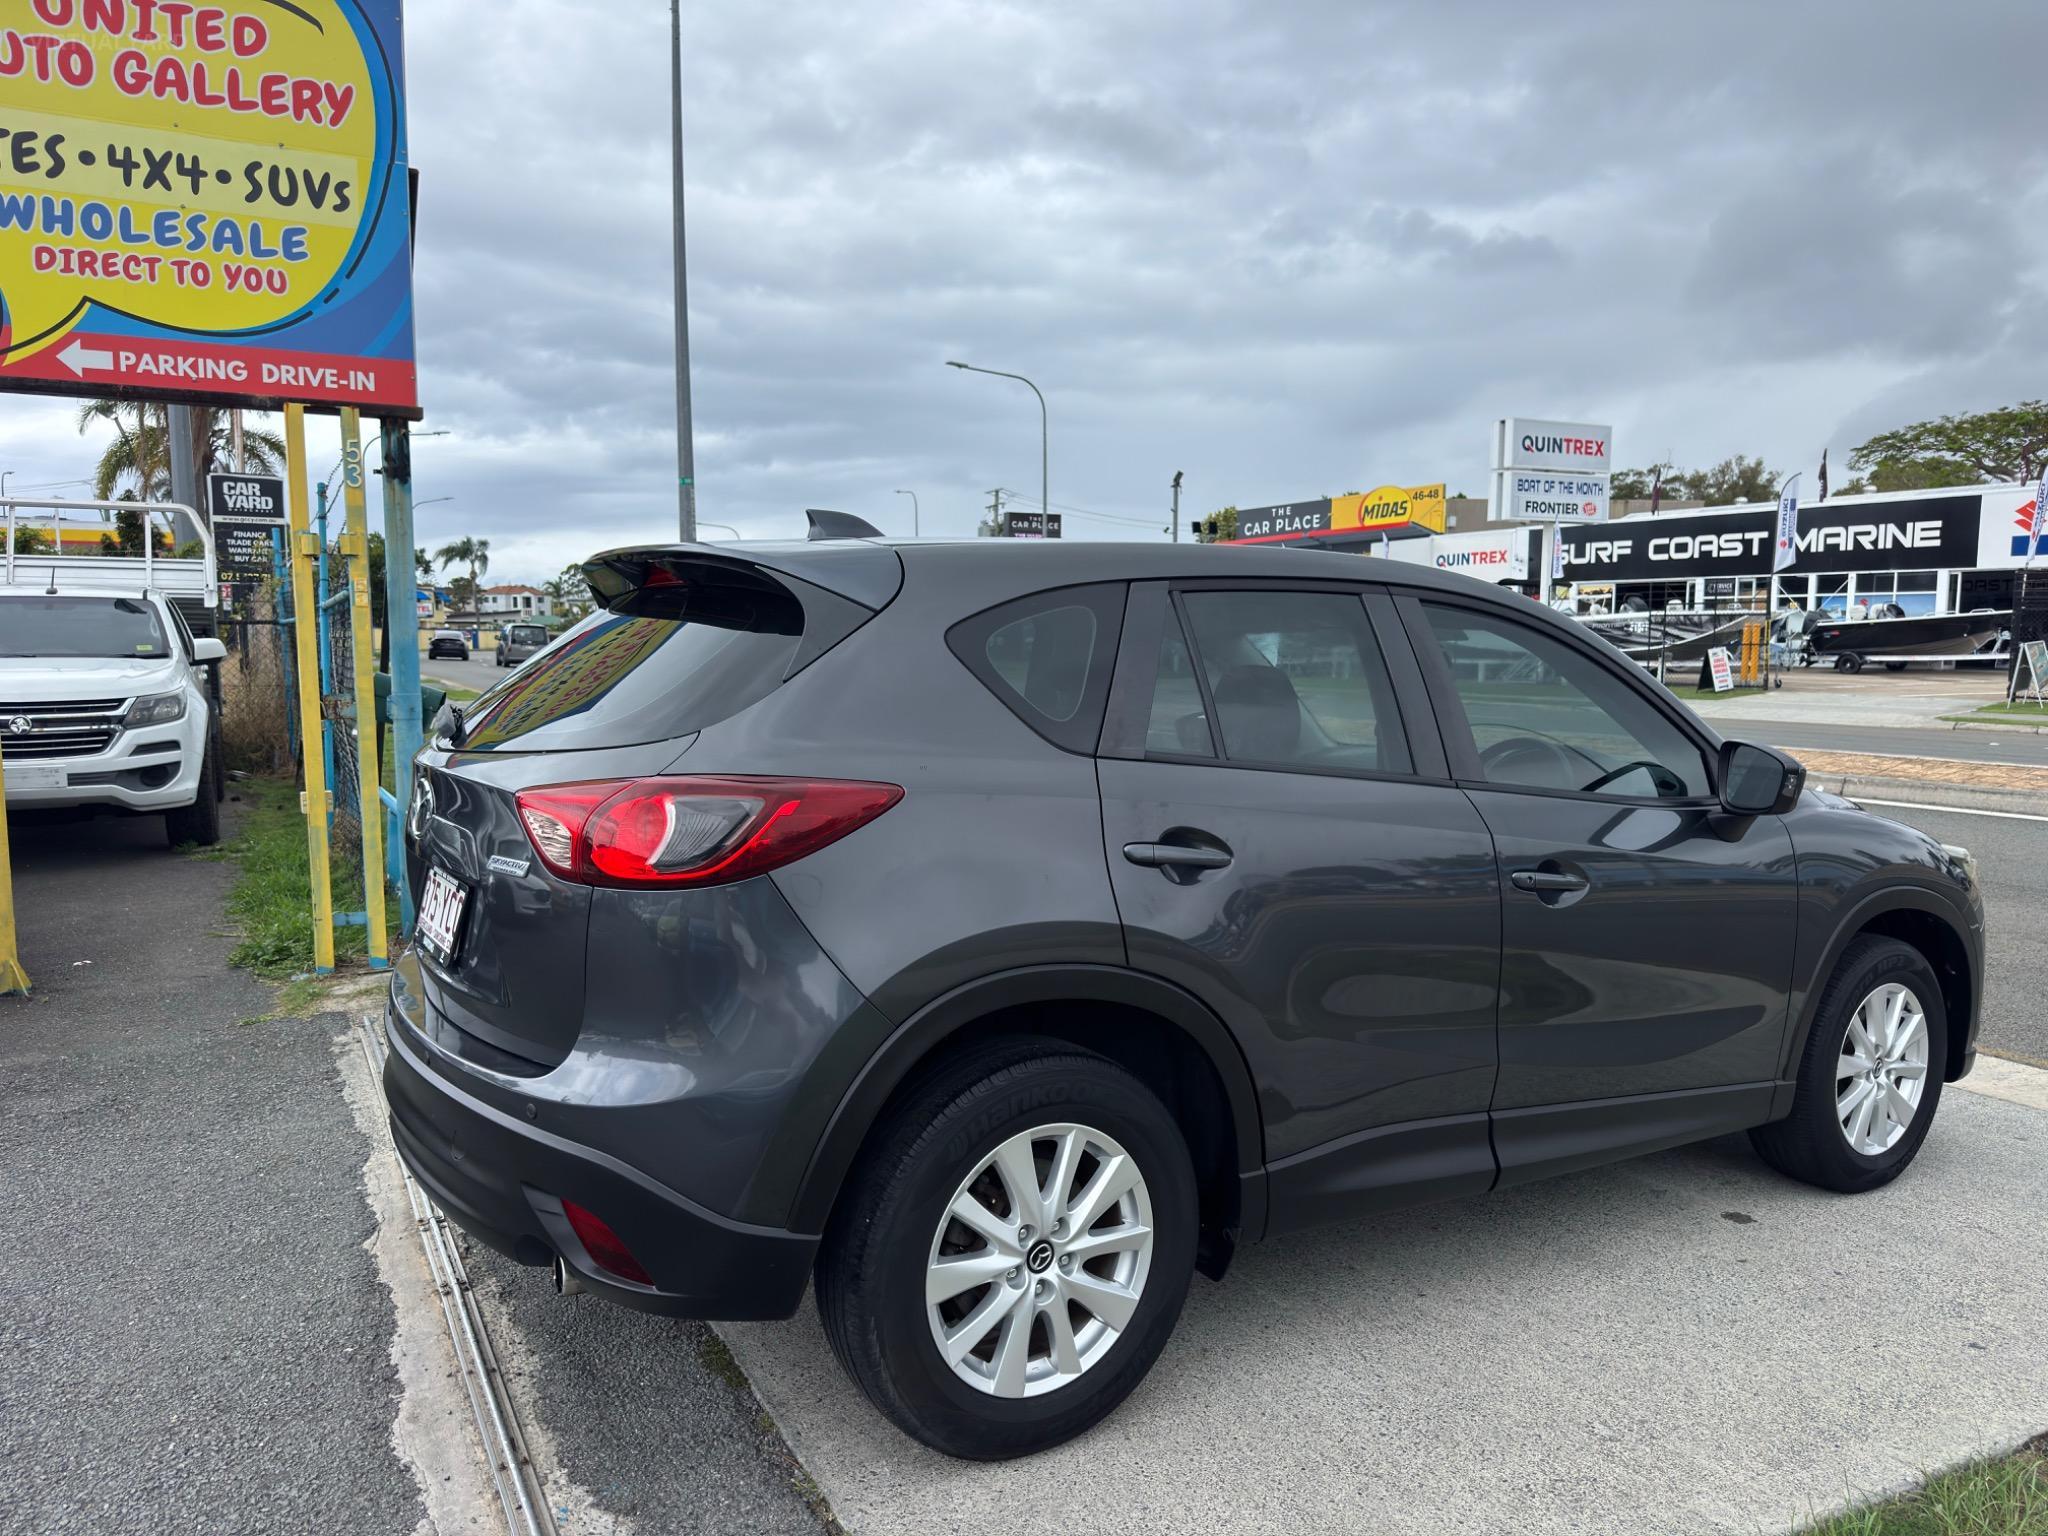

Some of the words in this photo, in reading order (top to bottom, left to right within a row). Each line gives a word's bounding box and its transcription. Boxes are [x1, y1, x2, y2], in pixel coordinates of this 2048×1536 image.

[31, 0, 268, 58] UNITED
[113, 50, 354, 128] GALLERY
[0, 194, 309, 262] WHOLESALE
[34, 246, 163, 283] DIRECT
[170, 259, 211, 287] TO
[223, 263, 288, 294] YOU
[120, 351, 249, 382] PARKING
[261, 363, 376, 392] DRIVE-IN
[1522, 435, 1605, 457] QUINTREX
[222, 481, 260, 496] CAR
[1412, 489, 1440, 501] 46-48
[1517, 478, 1541, 493] BOAT
[1543, 480, 1555, 494] OF
[1558, 481, 1574, 495] THE
[1576, 482, 1604, 497] MONTH
[224, 495, 273, 510] YARD
[1271, 506, 1292, 518] THE
[1525, 501, 1579, 515] FRONTIER
[1011, 520, 1029, 528] CAR
[1032, 521, 1059, 530] PLCE
[1244, 520, 1271, 536] CAR
[1275, 514, 1321, 533] PLACE
[226, 538, 251, 546] TRADE
[1648, 530, 1769, 561] COAST
[1795, 520, 1943, 553] MARINE
[1436, 550, 1508, 568] QUINTREX
